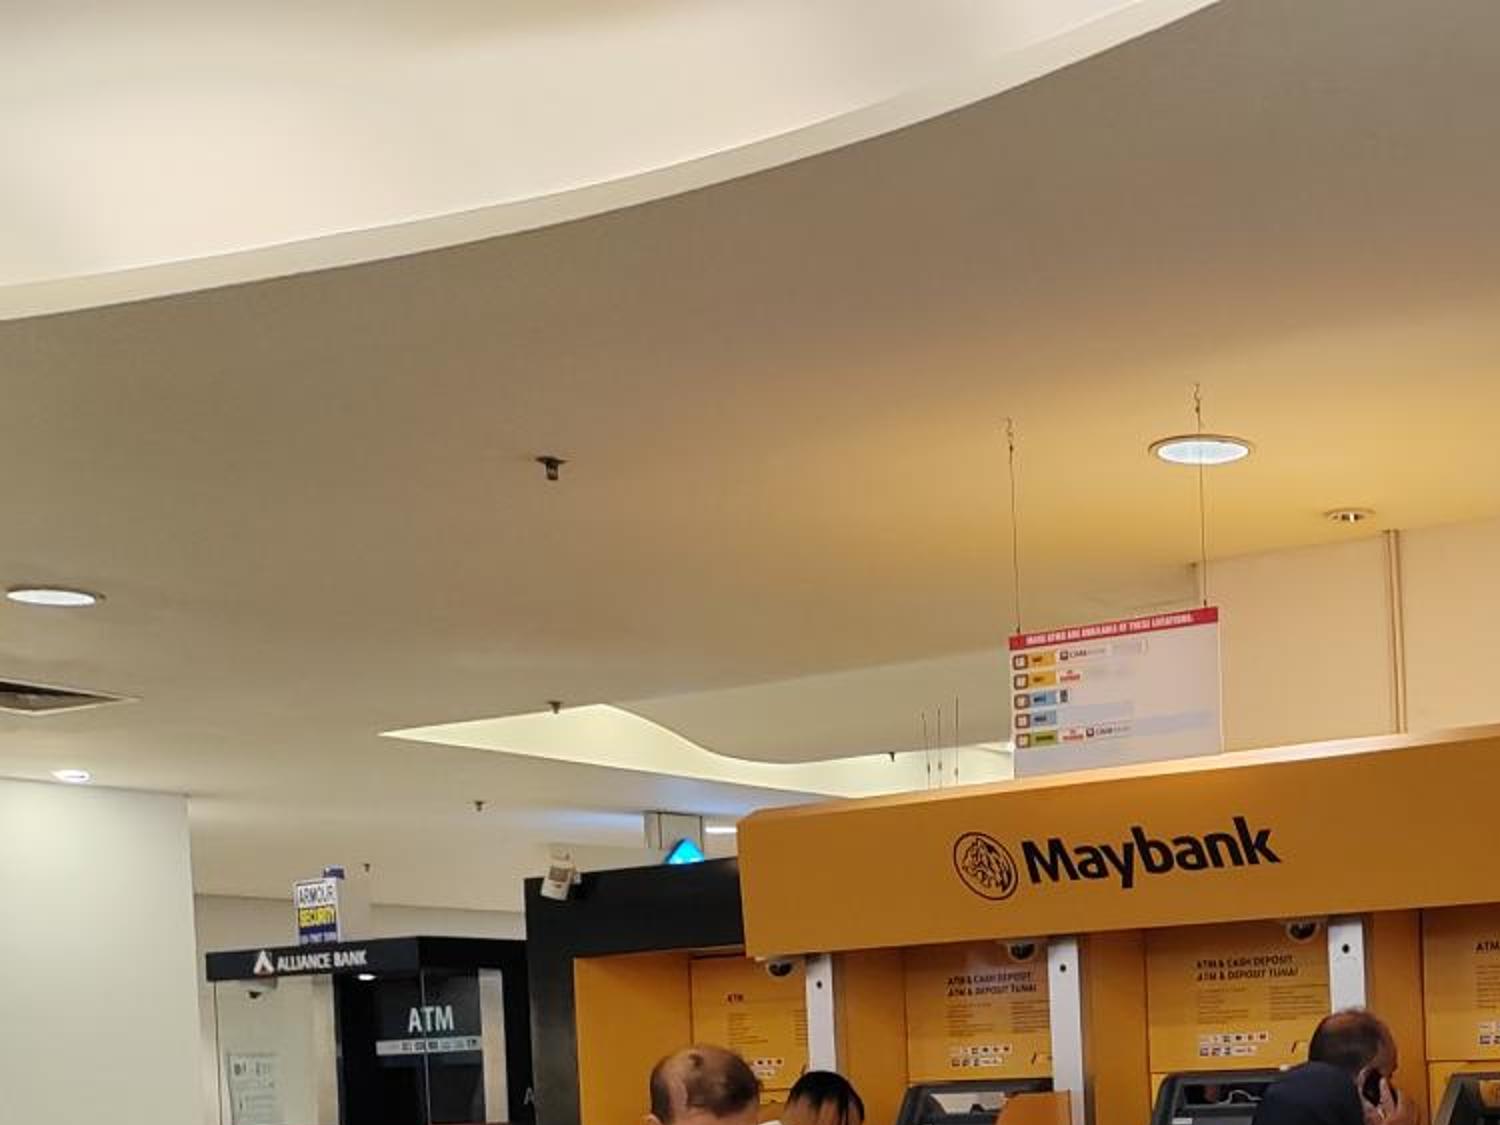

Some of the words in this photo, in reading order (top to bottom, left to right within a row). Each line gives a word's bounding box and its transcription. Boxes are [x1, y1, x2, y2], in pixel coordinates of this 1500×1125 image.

[1020, 816, 1281, 889] Maybank
[1475, 941, 1500, 952] ATM
[277, 953, 332, 971] ALLIANCE
[333, 949, 368, 968] BANK
[407, 1004, 455, 1034] ATM
